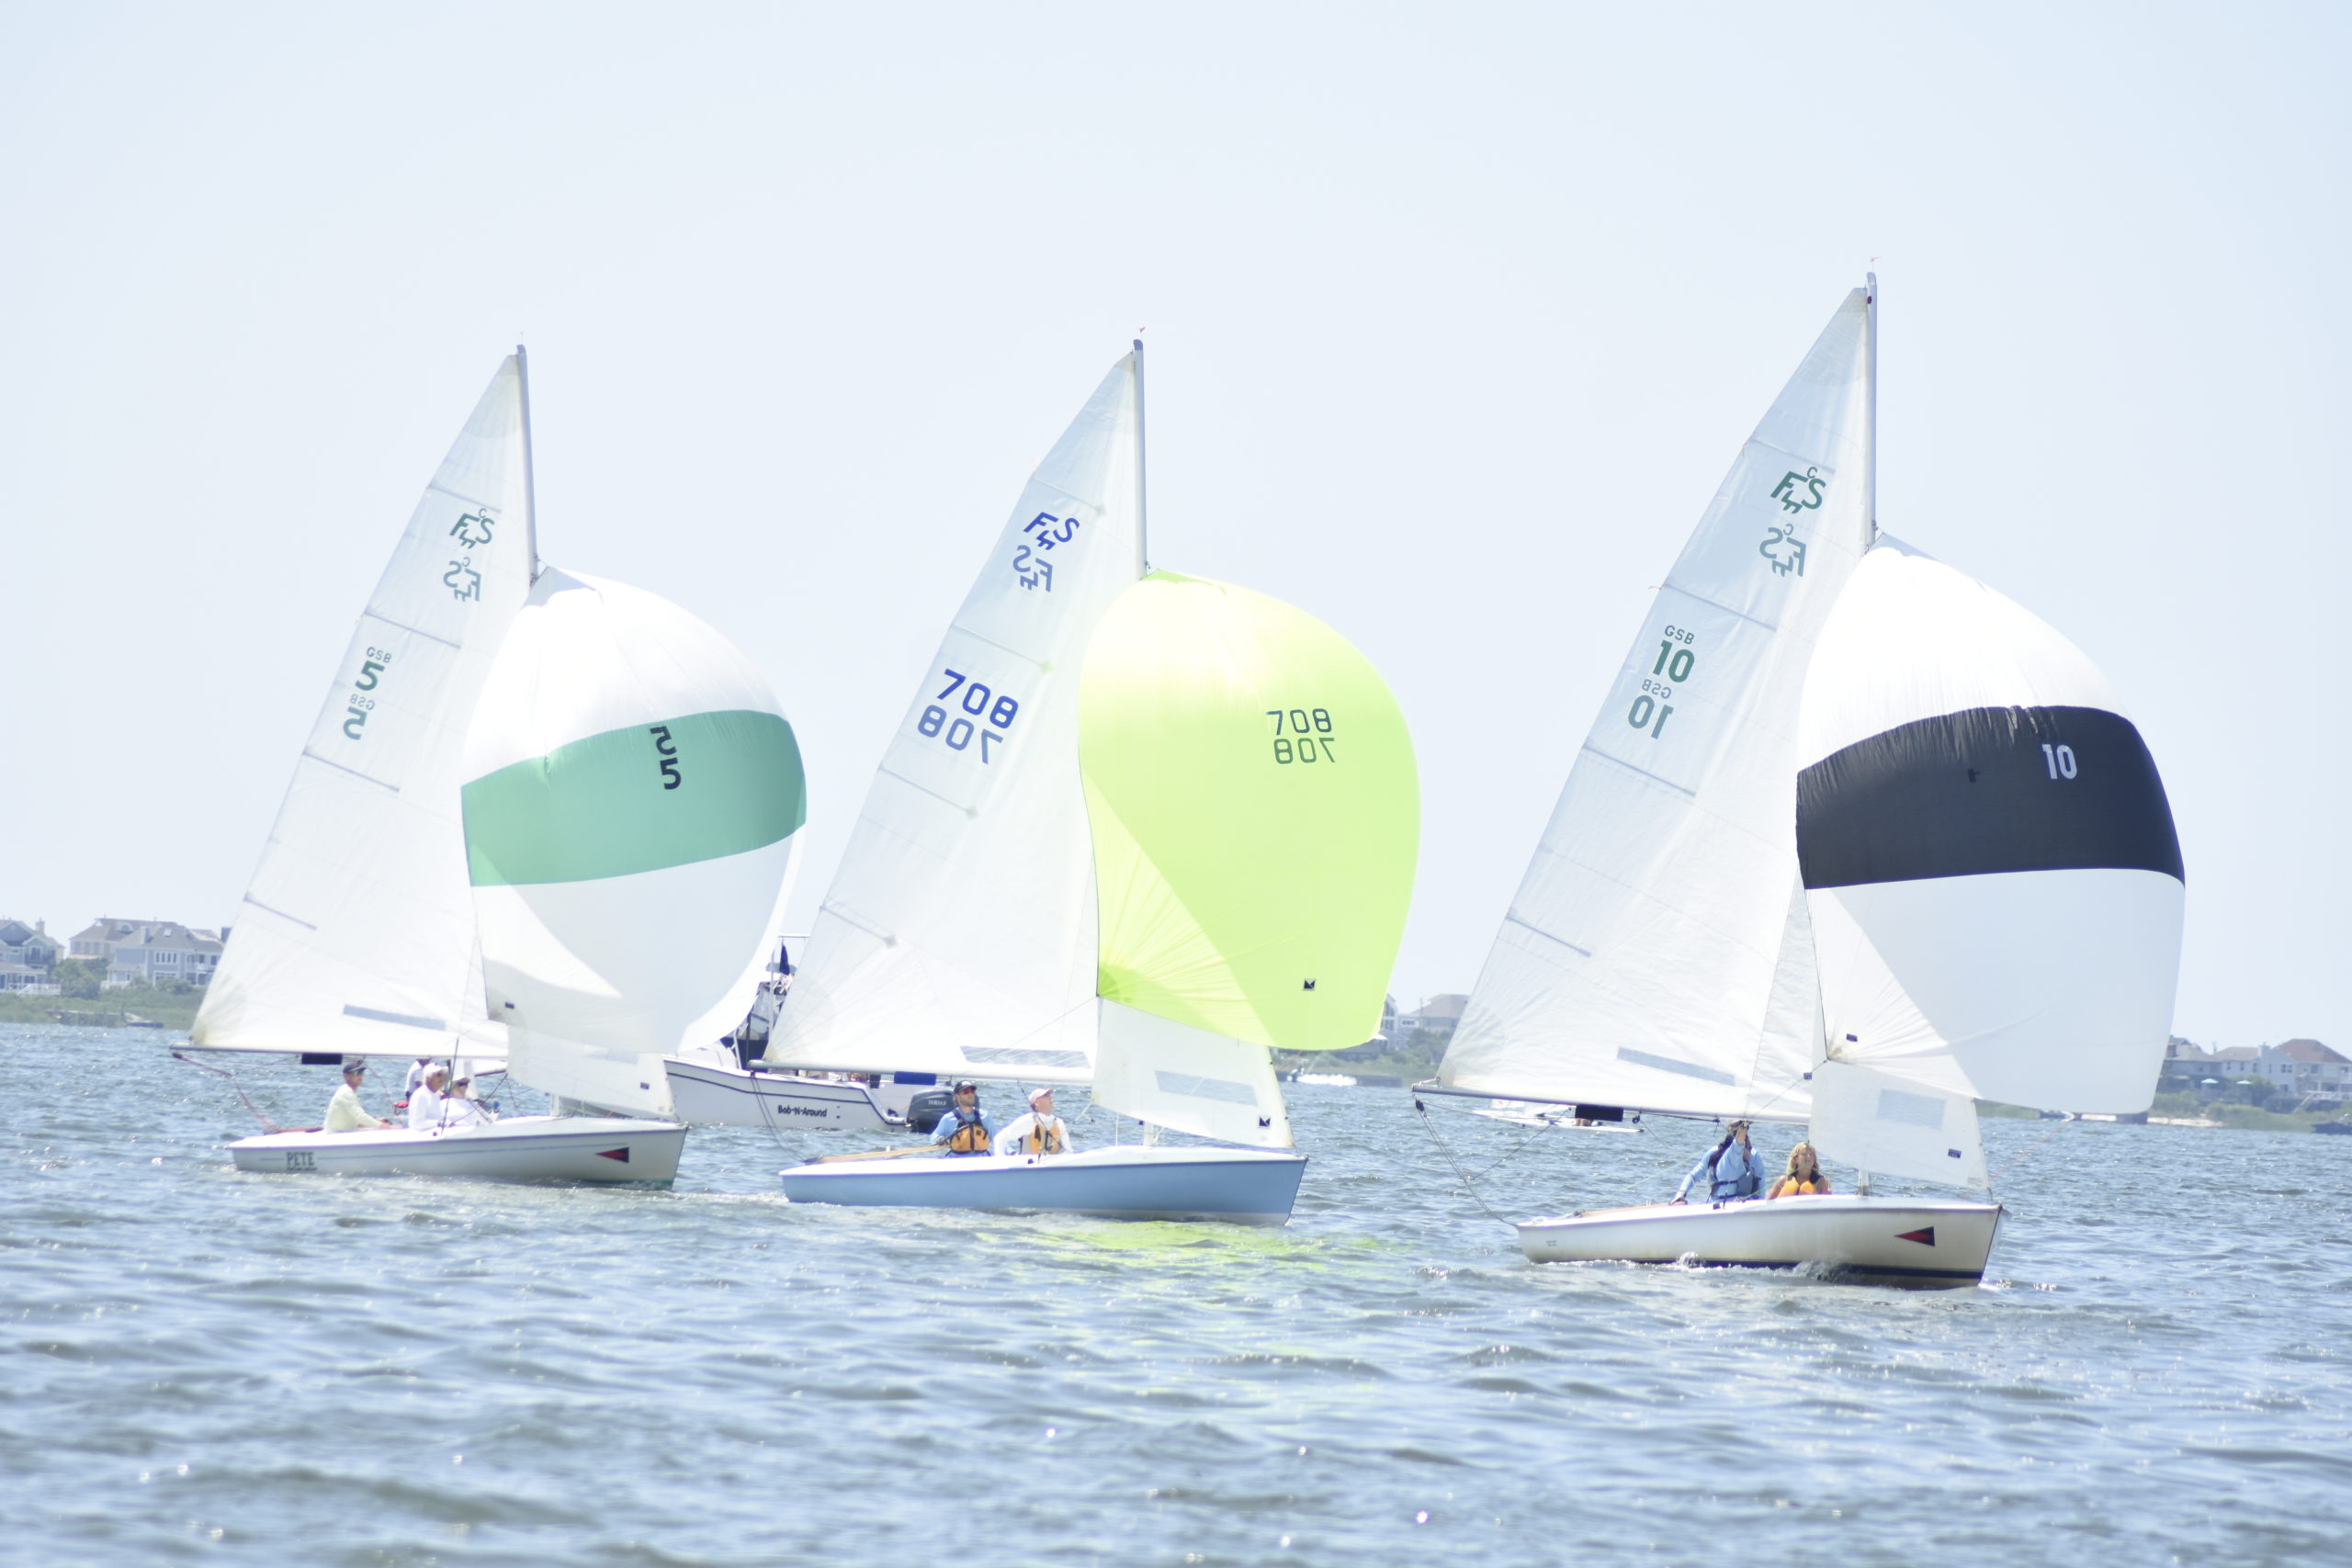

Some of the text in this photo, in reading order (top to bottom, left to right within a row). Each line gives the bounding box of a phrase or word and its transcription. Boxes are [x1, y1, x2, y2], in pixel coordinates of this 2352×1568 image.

[1664, 625, 1695, 645] GSB
[366, 647, 392, 663] GSB
[1652, 640, 1695, 682] 10
[355, 660, 385, 691] 5
[936, 669, 1019, 729] 708
[1266, 708, 1332, 736] 708
[660, 757, 682, 790] 5
[2041, 743, 2077, 780] 10
[286, 1152, 314, 1166] PETE
